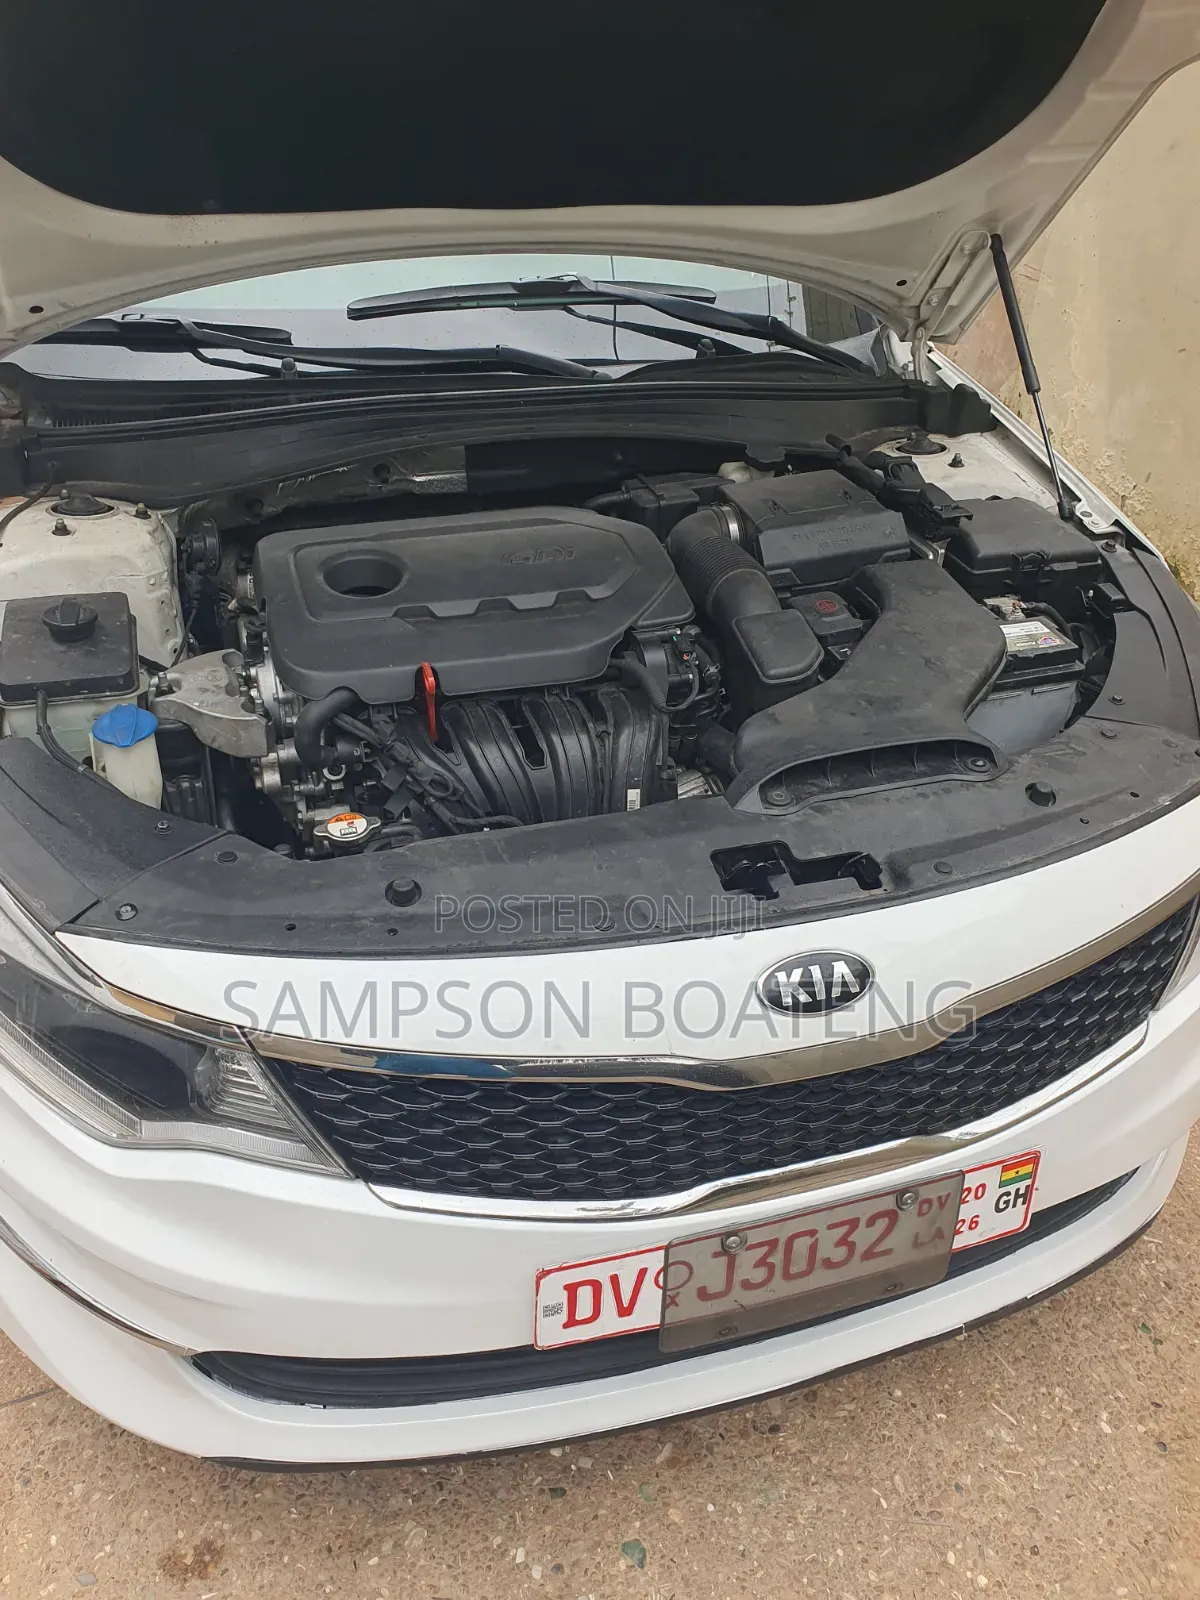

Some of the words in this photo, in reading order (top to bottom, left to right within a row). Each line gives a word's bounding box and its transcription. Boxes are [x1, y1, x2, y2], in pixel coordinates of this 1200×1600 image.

[775, 960, 861, 1006] KIA
[917, 1191, 952, 1218] DV
[960, 1182, 987, 1205] 20
[994, 1183, 1032, 1214] GH
[911, 1225, 946, 1251] LA
[954, 1213, 980, 1236] 26
[562, 1267, 649, 1330] DV
[696, 1208, 899, 1302] J3032
